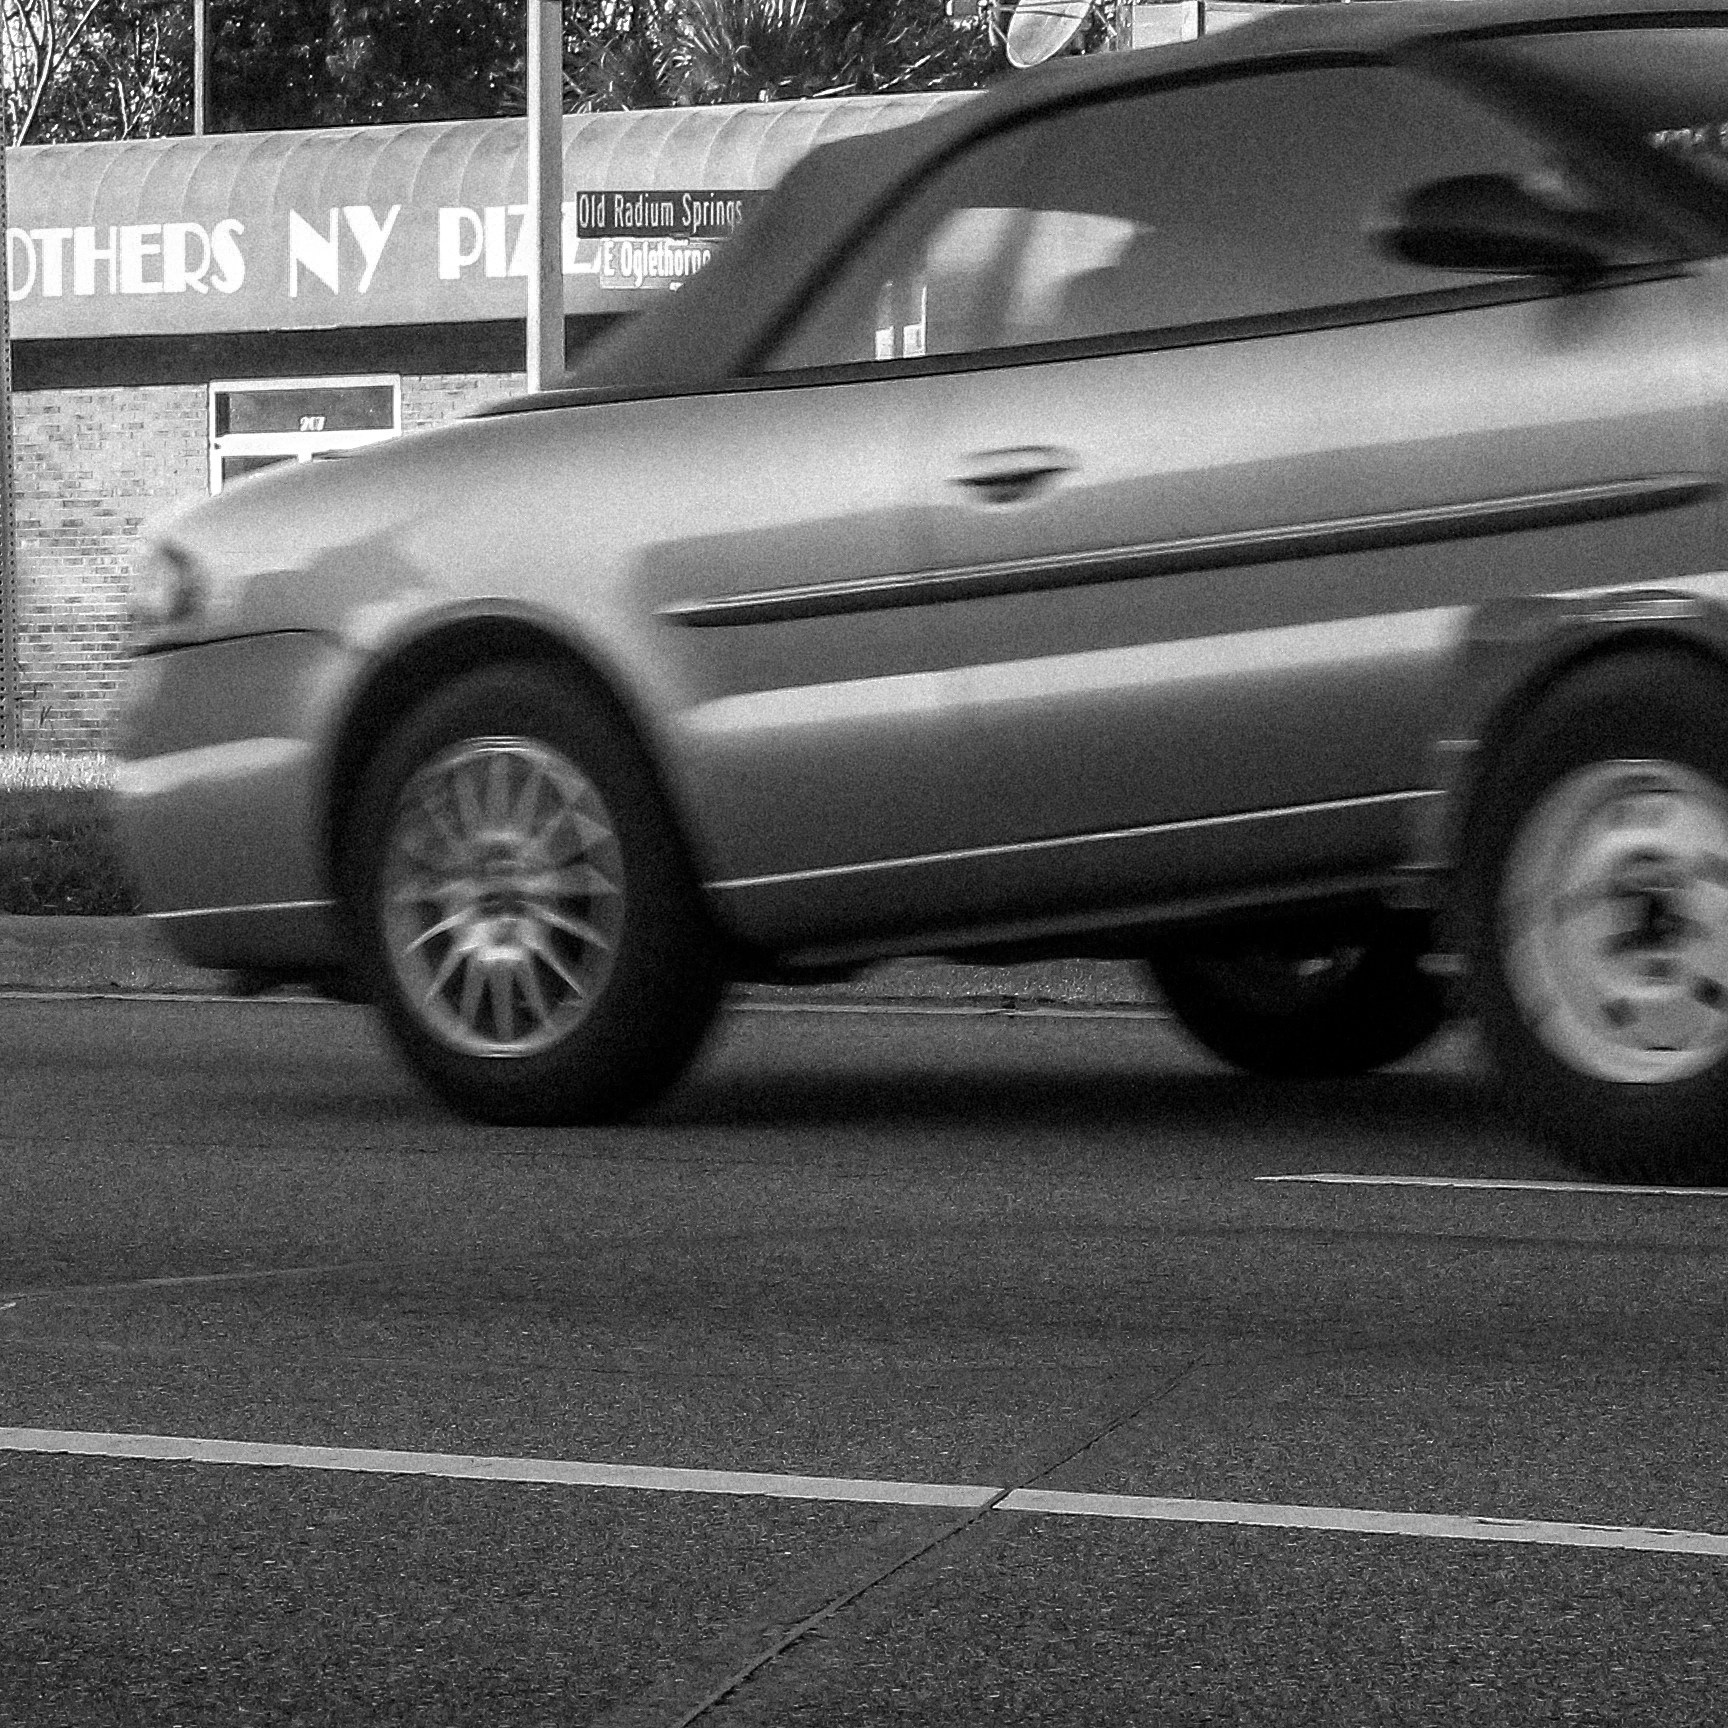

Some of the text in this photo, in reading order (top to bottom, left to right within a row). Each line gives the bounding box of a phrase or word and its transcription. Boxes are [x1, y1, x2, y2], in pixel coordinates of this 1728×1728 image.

[579, 192, 743, 234] Old Radium Springs
[288, 203, 402, 298] NY
[603, 240, 616, 277] E
